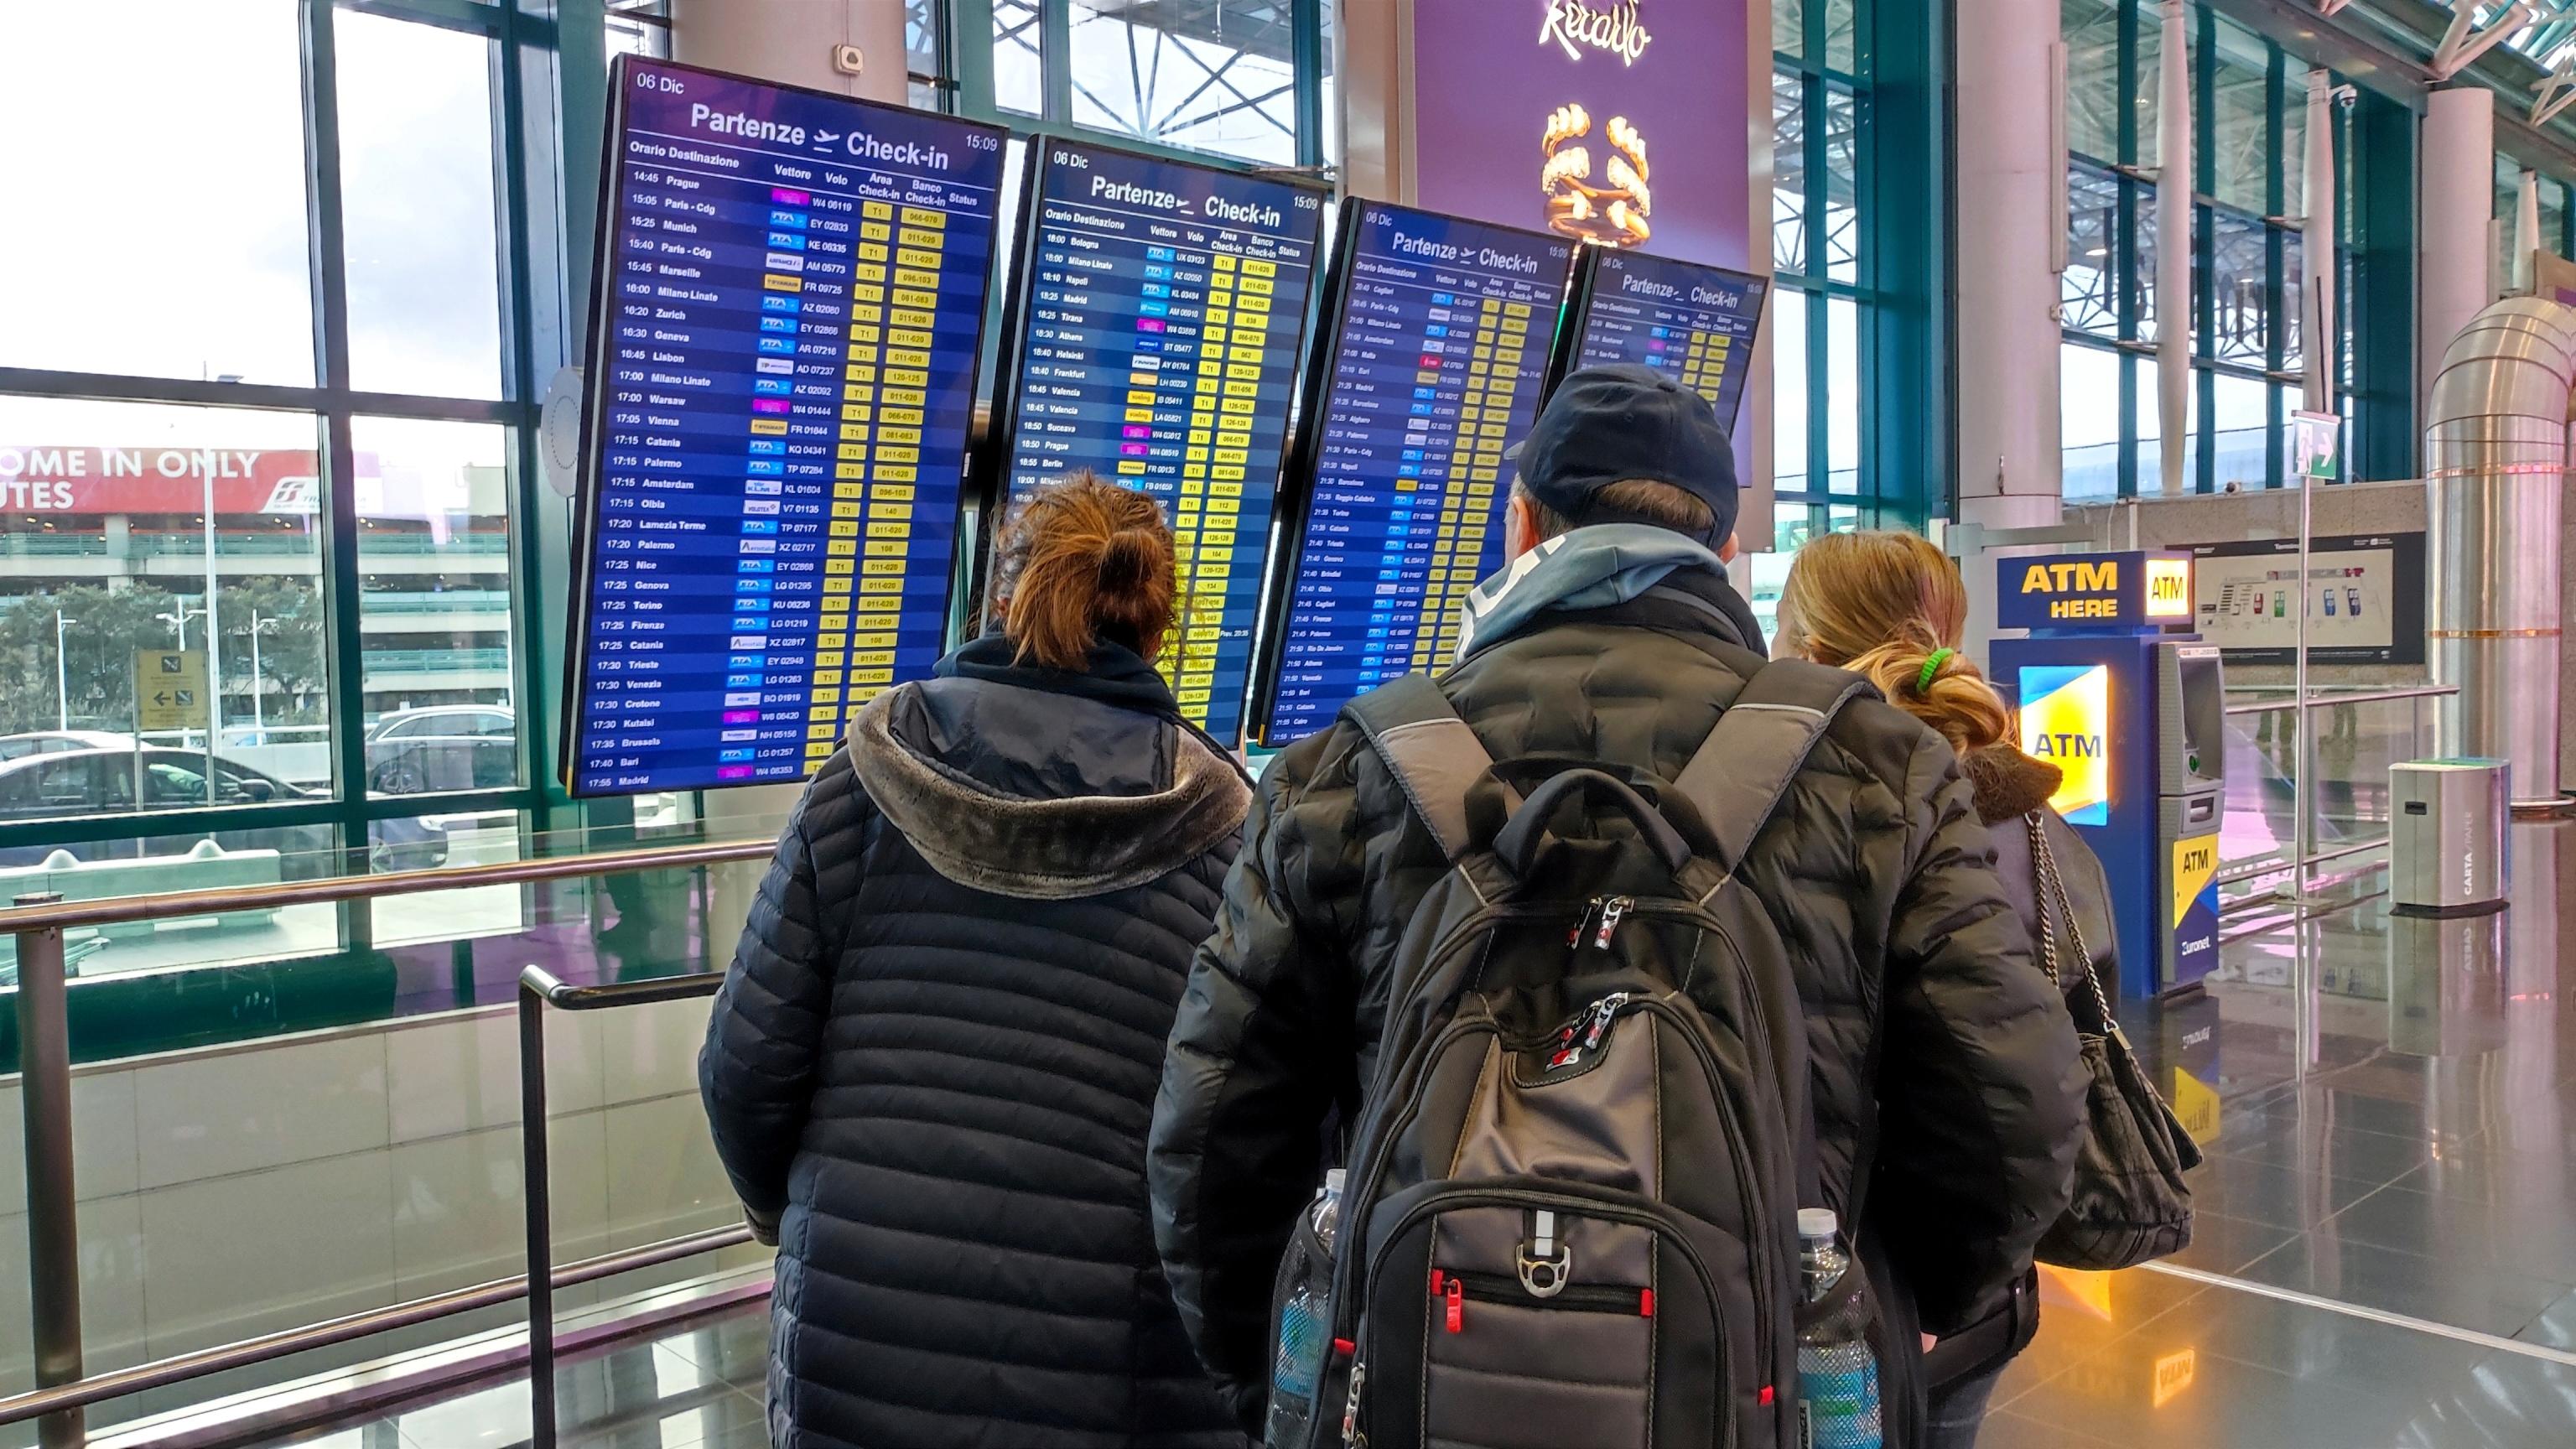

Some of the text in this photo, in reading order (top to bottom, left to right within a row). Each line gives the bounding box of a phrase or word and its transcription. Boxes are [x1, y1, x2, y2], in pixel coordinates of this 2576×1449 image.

[636, 72, 683, 94] 06 Dic
[691, 102, 948, 169] Partenze Check-in
[966, 134, 997, 151] 15:09
[630, 141, 848, 184] Orario Destinazione Vettore Volo
[1053, 150, 1088, 169] 06 Dic
[634, 171, 699, 189] 14:45 Prague
[869, 172, 892, 184] Area
[858, 184, 900, 200] Check-in
[911, 179, 942, 193] Banco
[905, 191, 945, 206] Check-in
[948, 192, 977, 205] Status
[1091, 175, 1280, 226] Partenze Check-in
[1294, 195, 1317, 210] 15:09
[632, 194, 715, 216] 15:05 Paris Cdg
[631, 216, 697, 233] 15:25 Munich
[1045, 208, 1204, 242] Orario Destinazione Vettore Volo
[1219, 230, 1237, 241] Area
[1251, 235, 1274, 247] Banco
[629, 238, 711, 259] 15:40 Paris Cdg
[1070, 236, 1098, 249] Bologna
[1211, 240, 1242, 252] Check-in
[1245, 246, 1275, 257] Check-in
[1278, 245, 1300, 257] Status
[1392, 231, 1537, 273] Partenze Check-in
[1067, 256, 1091, 267] Milano
[1091, 259, 1112, 269] Linate
[627, 261, 700, 278] 15:45 Marseille
[1065, 274, 1088, 285] Napoli
[657, 286, 688, 298] Milano
[689, 290, 718, 301] Linate
[1622, 274, 1673, 297] Partenze
[1690, 286, 1737, 308] Check-in
[1063, 293, 1087, 304] Madrid
[655, 308, 685, 319] Zurich
[1061, 312, 1083, 322] Tirana
[654, 330, 689, 341] Geneva
[1058, 331, 1083, 341] Athens
[652, 351, 684, 362] Lisbon
[1056, 350, 1083, 360] Helsinki
[619, 371, 710, 386] 17:00 Milano Linate
[1054, 368, 1085, 378] Frankfurt
[1052, 387, 1080, 396] Valencia
[617, 392, 685, 405] 17:00 Warsaw
[1049, 404, 1078, 414] Valencia
[616, 413, 679, 425] 17:05 Vienna
[1046, 423, 1075, 432] Suceava
[615, 434, 680, 447] 17:15 Catania
[1044, 441, 1068, 451] Prague
[101, 449, 143, 477] IN
[157, 450, 259, 478] ONLY
[613, 455, 682, 467] 17:15 Palermo
[1041, 459, 1062, 467] Berlin
[610, 477, 693, 488] 17:15 Amsterdam
[610, 498, 665, 508] 17:15 Olbia
[608, 518, 706, 529] 17:20 Lamezia Terme
[606, 539, 675, 548] 17:20 Palermo
[605, 560, 657, 569] 17:25 Nice
[2021, 562, 2117, 593] ATM
[604, 580, 669, 589] 17:25 Genova
[2153, 576, 2183, 600] ATM
[602, 600, 662, 610] 17:25 Torino
[2051, 599, 2117, 618] HERE
[600, 621, 664, 630] 17:25 Firenze
[599, 641, 663, 649] 17:25 Catania
[597, 660, 658, 669] 17:30 Trieste
[595, 680, 661, 689] 17:30 Venezia
[595, 699, 660, 709] 17:30 Crotone
[593, 718, 654, 728] 17:30 Kutaisi
[591, 737, 660, 748] 17:35 Brussels
[2033, 734, 2101, 758] ATM
[589, 757, 638, 767] 17:40 Bari
[589, 776, 649, 787] 17:55 Madrid
[2183, 849, 2208, 874] ATM
